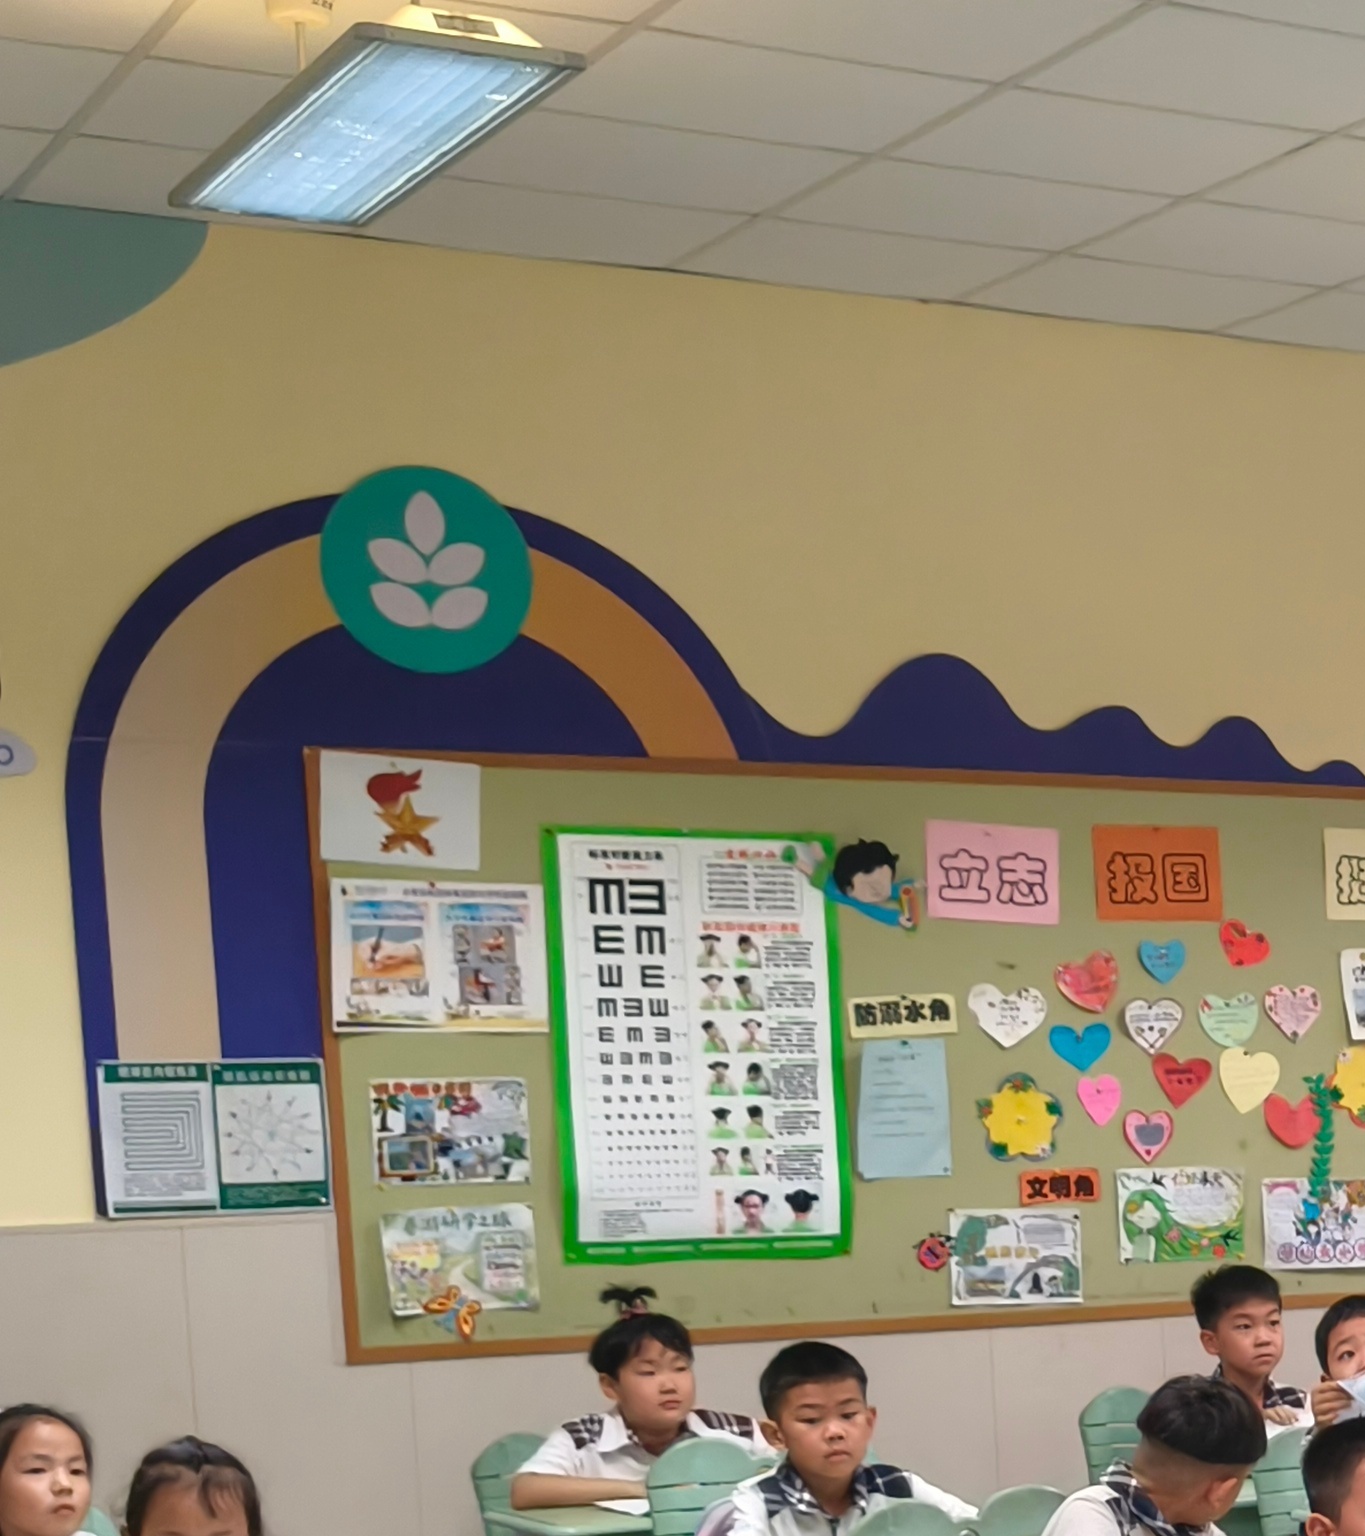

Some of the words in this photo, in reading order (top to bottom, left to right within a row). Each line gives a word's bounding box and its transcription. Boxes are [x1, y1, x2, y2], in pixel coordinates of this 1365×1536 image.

[938, 848, 1049, 907] 立志
[1106, 850, 1210, 905] 报国
[1026, 1174, 1095, 1200] 文明角
